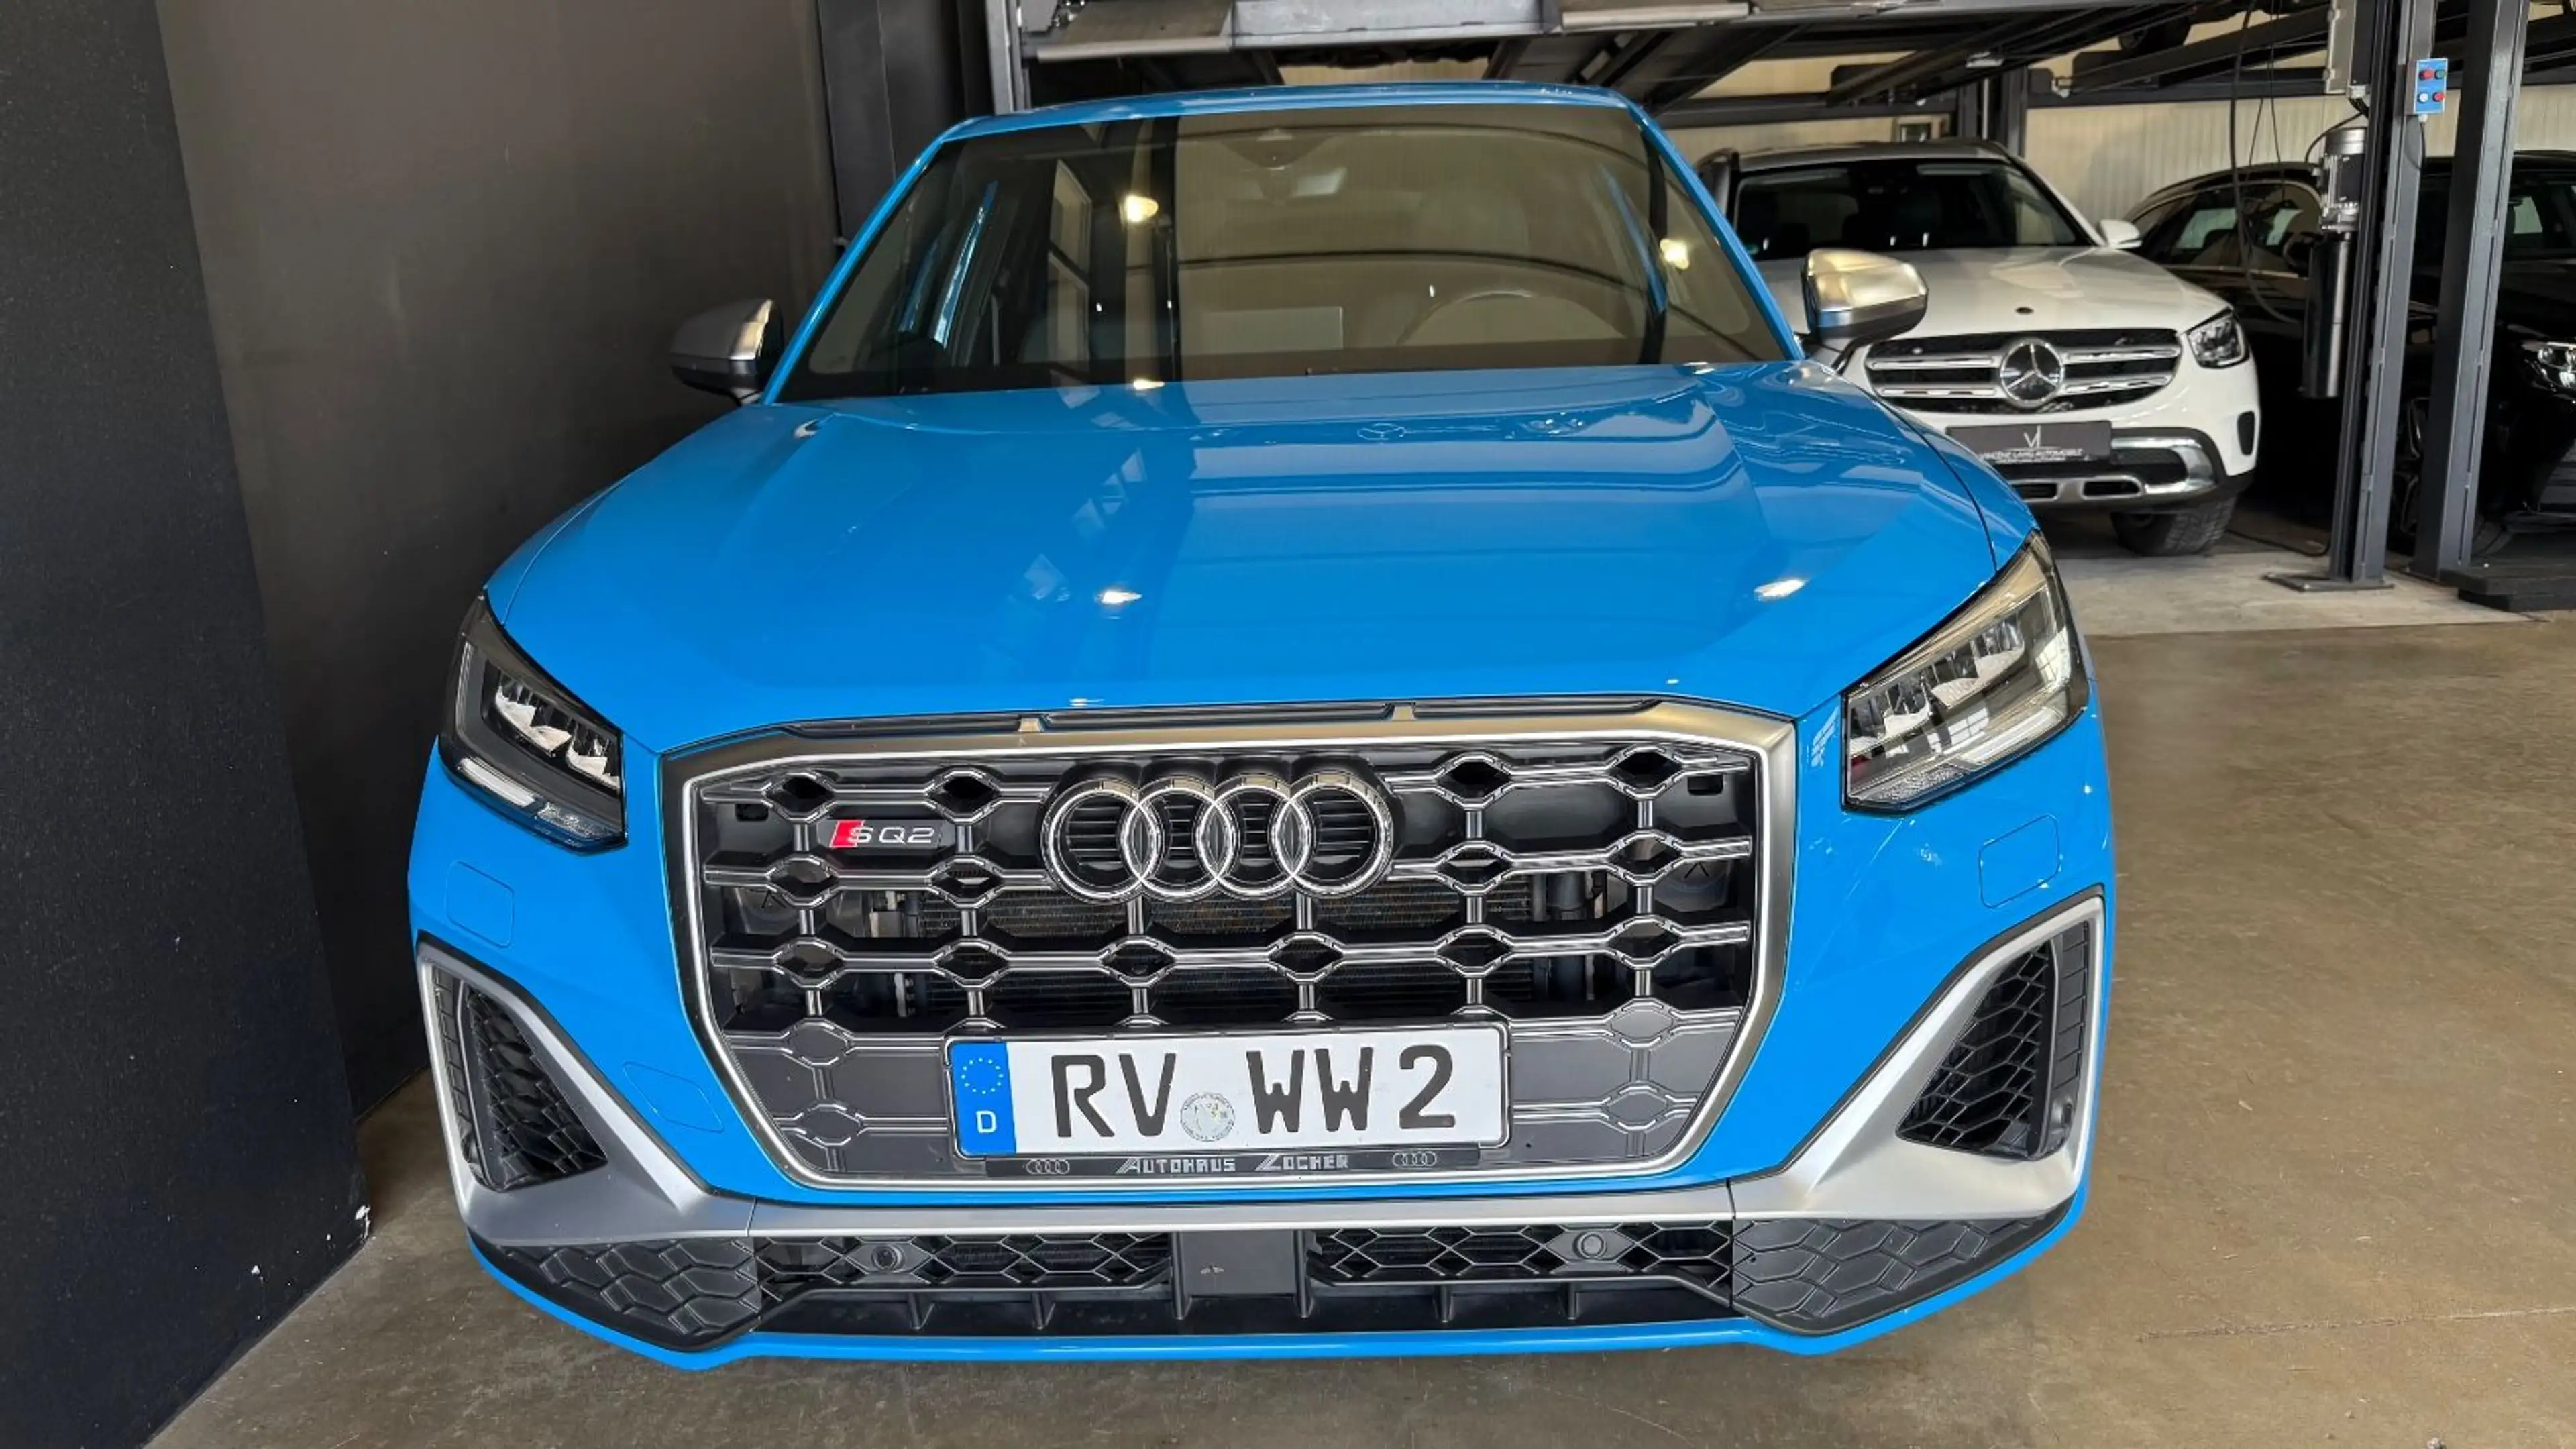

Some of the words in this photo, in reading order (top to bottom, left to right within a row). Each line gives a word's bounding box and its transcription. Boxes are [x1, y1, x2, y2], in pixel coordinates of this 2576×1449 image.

[847, 826, 935, 845] SQ2
[1051, 1052, 1177, 1138] RV
[1246, 1046, 1374, 1135] WW
[1399, 1044, 1456, 1129] 2
[976, 1110, 997, 1134] D
[1115, 1156, 1236, 1175] AUTOHAUS
[1255, 1152, 1349, 1171] ZOCHER
